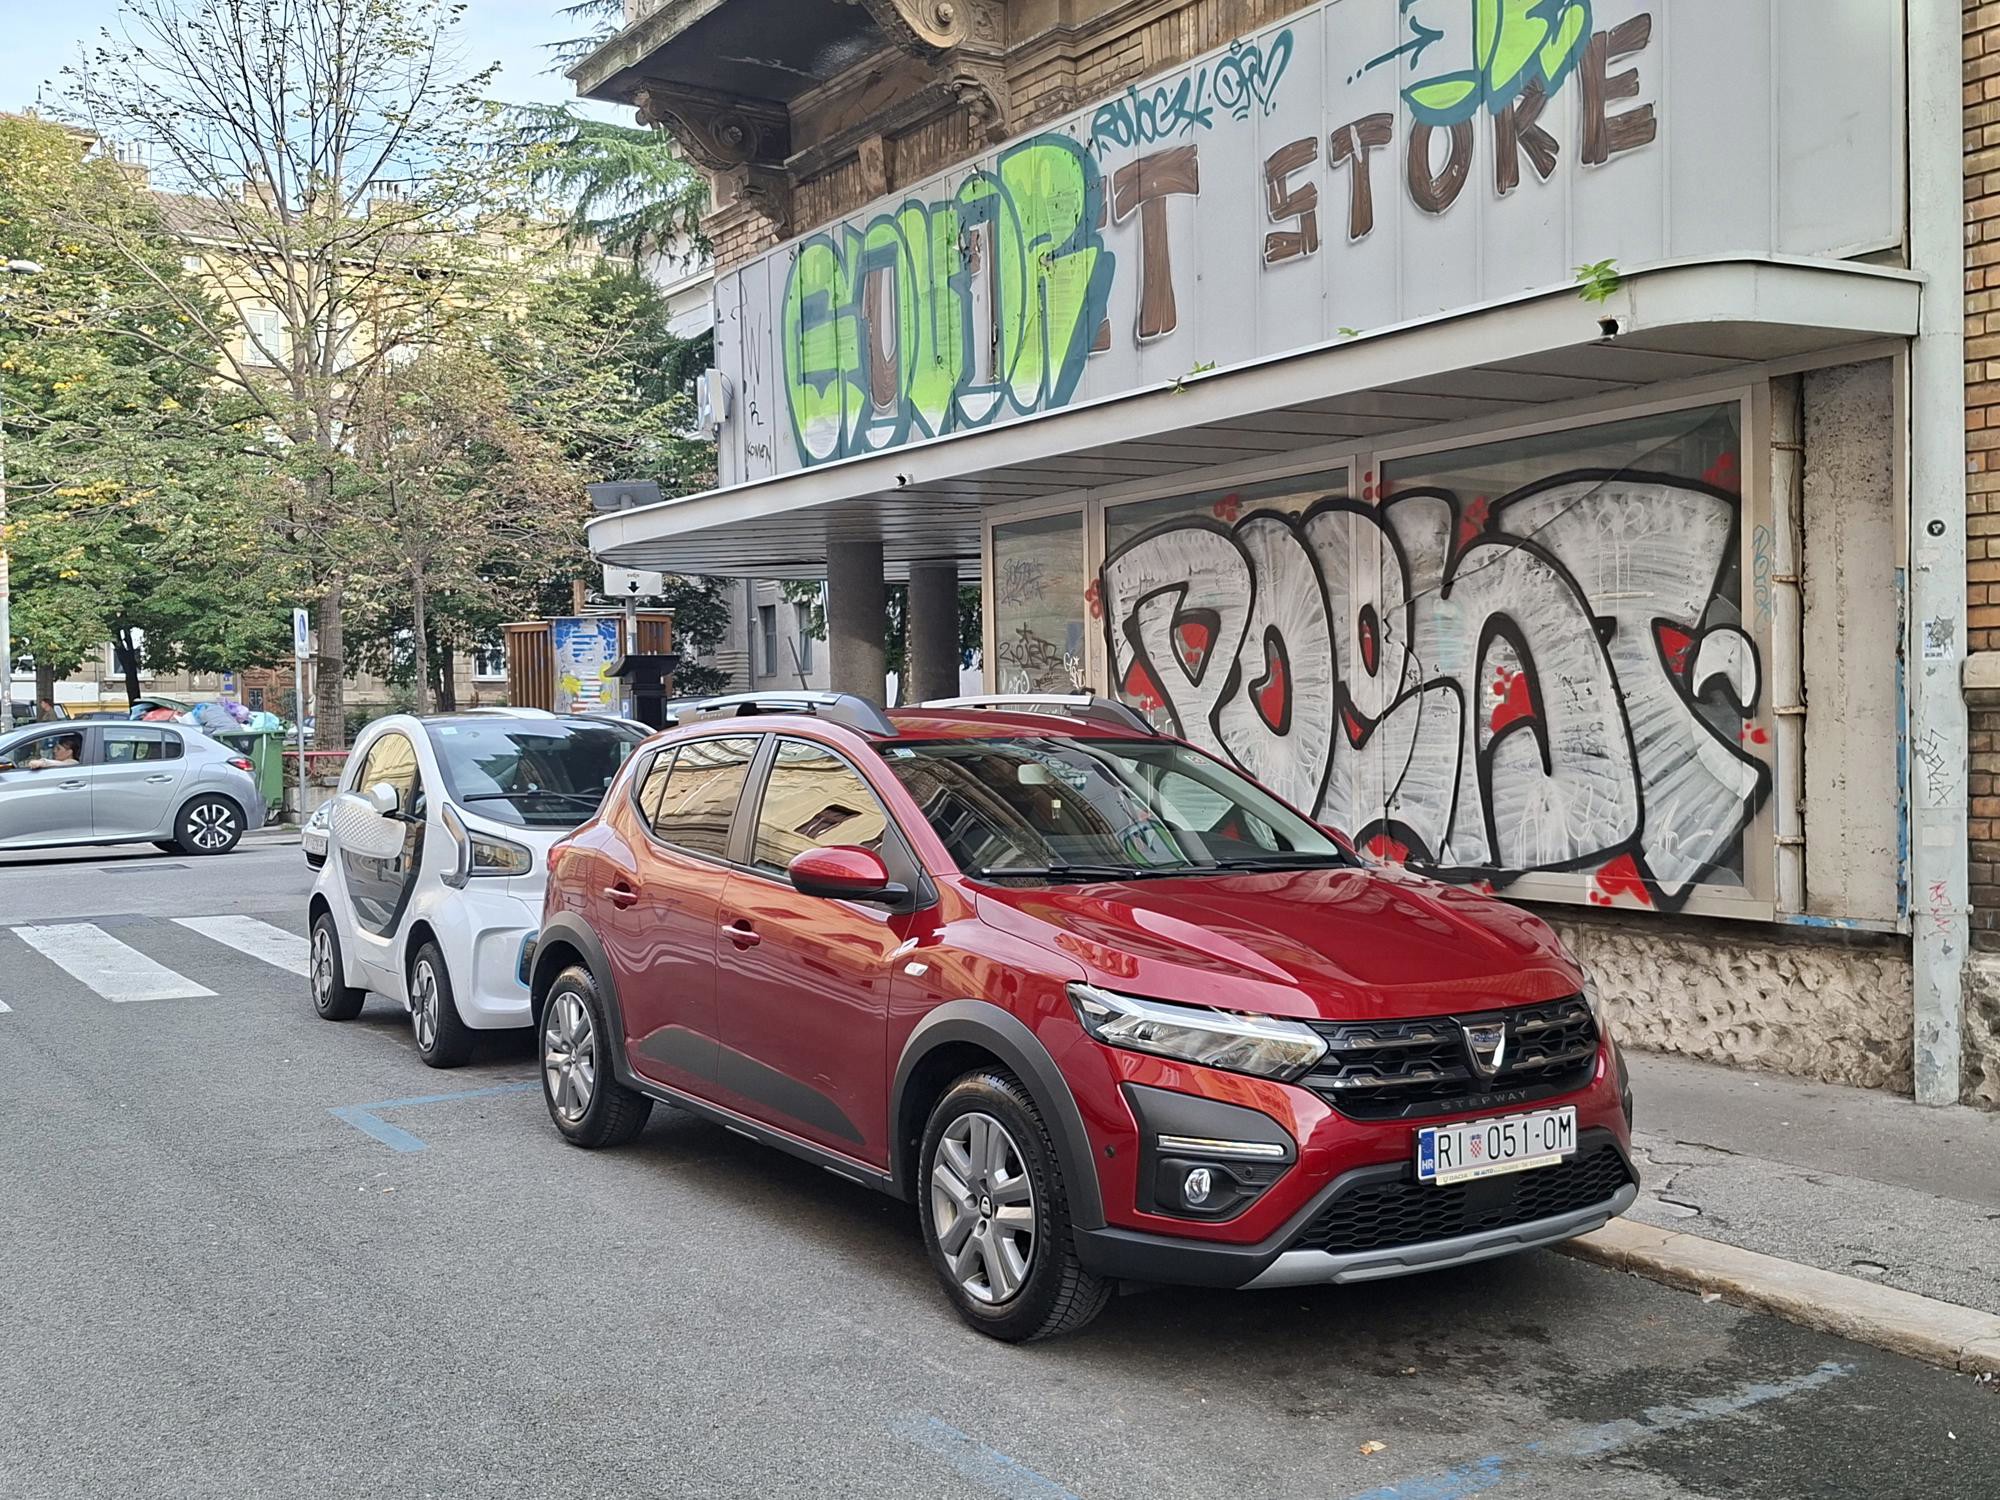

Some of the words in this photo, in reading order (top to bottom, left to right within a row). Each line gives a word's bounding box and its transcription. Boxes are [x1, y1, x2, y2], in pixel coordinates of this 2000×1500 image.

[1440, 1090, 1527, 1110] STEPWAY
[1438, 1131, 1463, 1169] RI
[1487, 1114, 1572, 1160] 051-OM
[1422, 1158, 1434, 1171] HR
